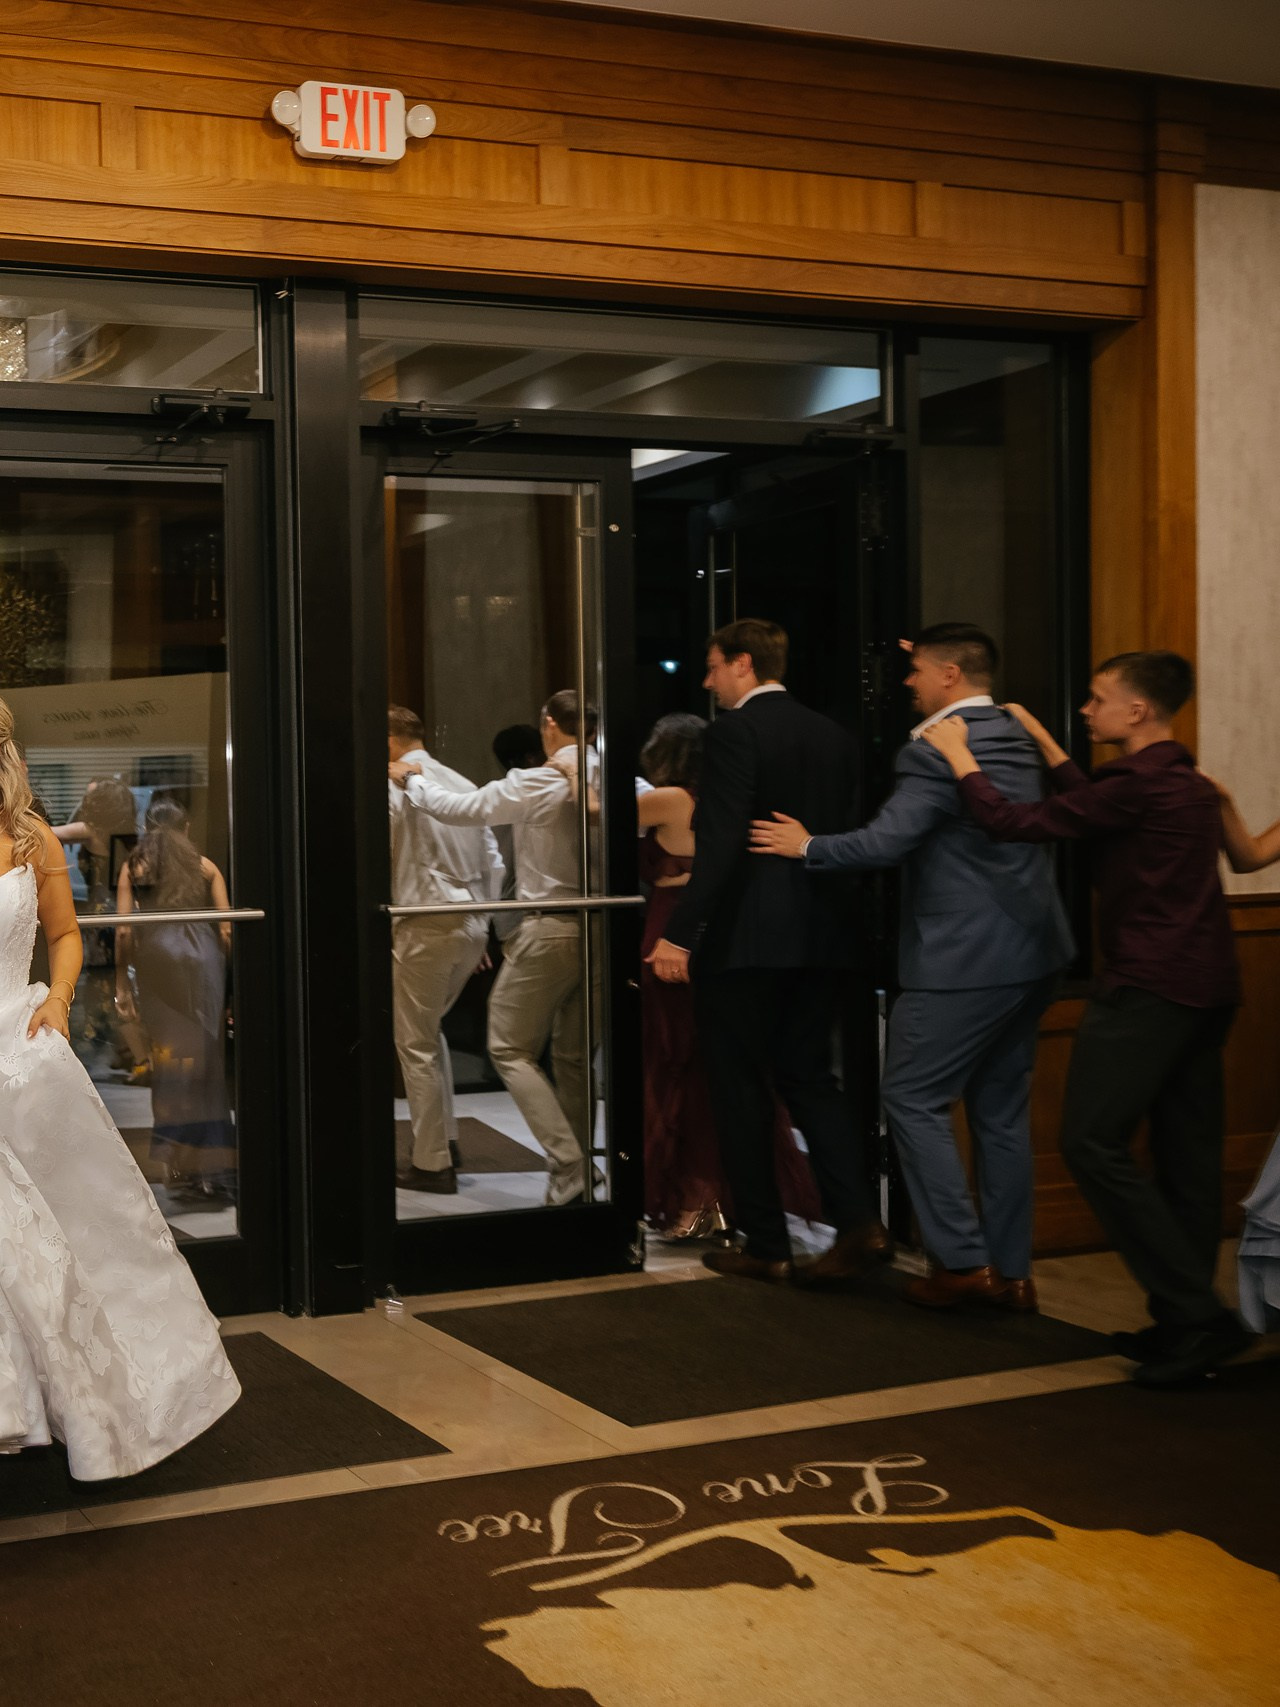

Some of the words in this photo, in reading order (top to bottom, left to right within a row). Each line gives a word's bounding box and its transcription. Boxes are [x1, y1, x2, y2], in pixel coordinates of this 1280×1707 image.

[321, 87, 391, 152] EXIT
[702, 1453, 949, 1517] Lone
[437, 1482, 686, 1577] Tree
